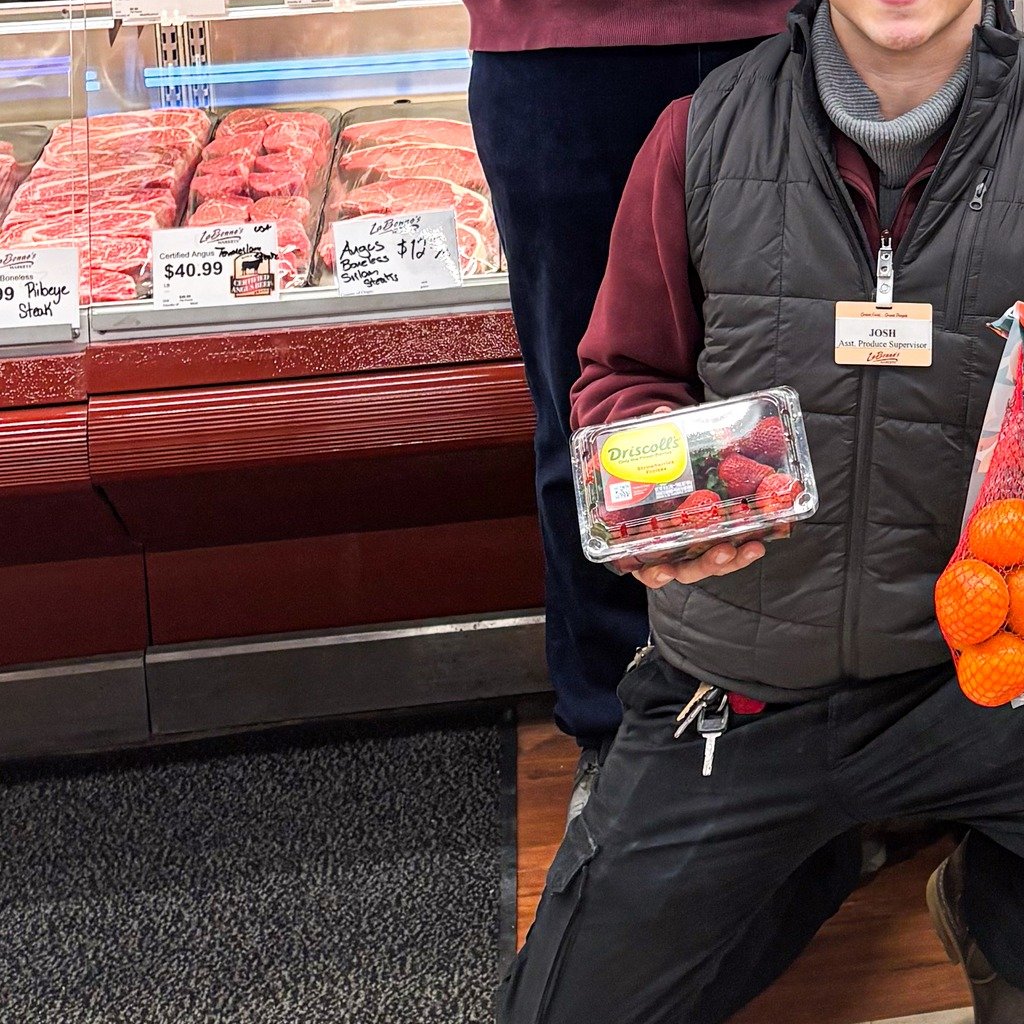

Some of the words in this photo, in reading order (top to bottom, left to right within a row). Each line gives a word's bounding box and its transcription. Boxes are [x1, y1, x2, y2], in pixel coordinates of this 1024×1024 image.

[200, 228, 244, 243] LaBonne's
[159, 251, 190, 260] Certified
[191, 250, 215, 258] Angus
[340, 240, 385, 260] Angus
[164, 261, 223, 280] $40.99
[25, 281, 70, 305] Ribeye
[19, 302, 53, 319] Steak
[869, 328, 896, 338] JOSH
[858, 340, 887, 348] Produce
[889, 341, 927, 350] Supervisor
[608, 436, 680, 461] Driscoll's
